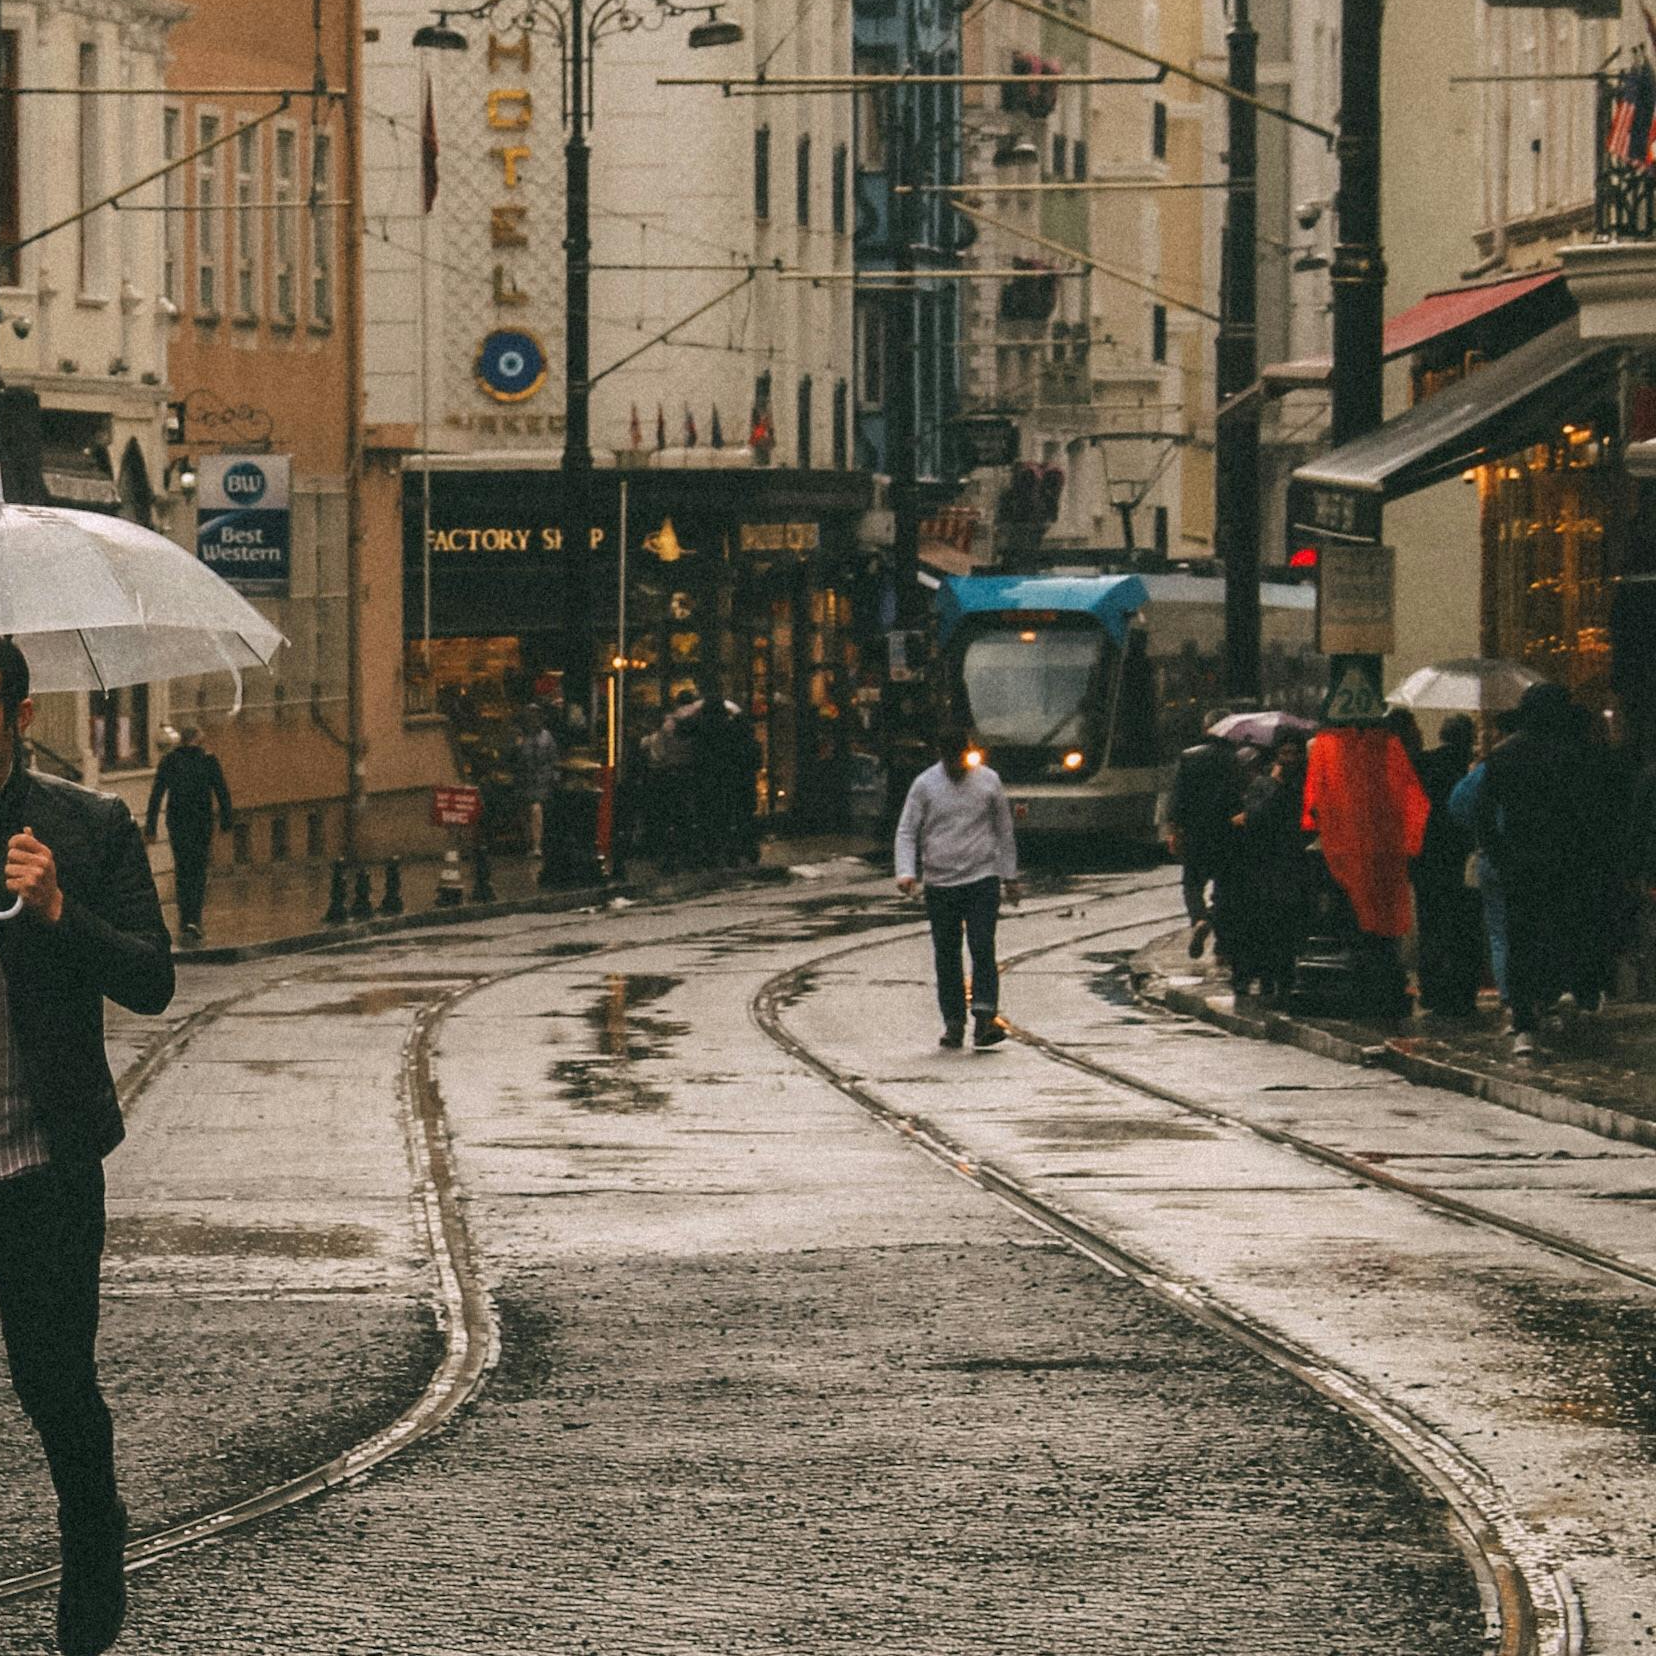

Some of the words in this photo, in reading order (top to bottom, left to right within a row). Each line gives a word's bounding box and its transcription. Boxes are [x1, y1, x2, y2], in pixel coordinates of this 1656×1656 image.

[487, 32, 533, 306] HOTEL
[227, 474, 262, 493] BW
[221, 526, 263, 543] Best
[202, 544, 282, 561] Western
